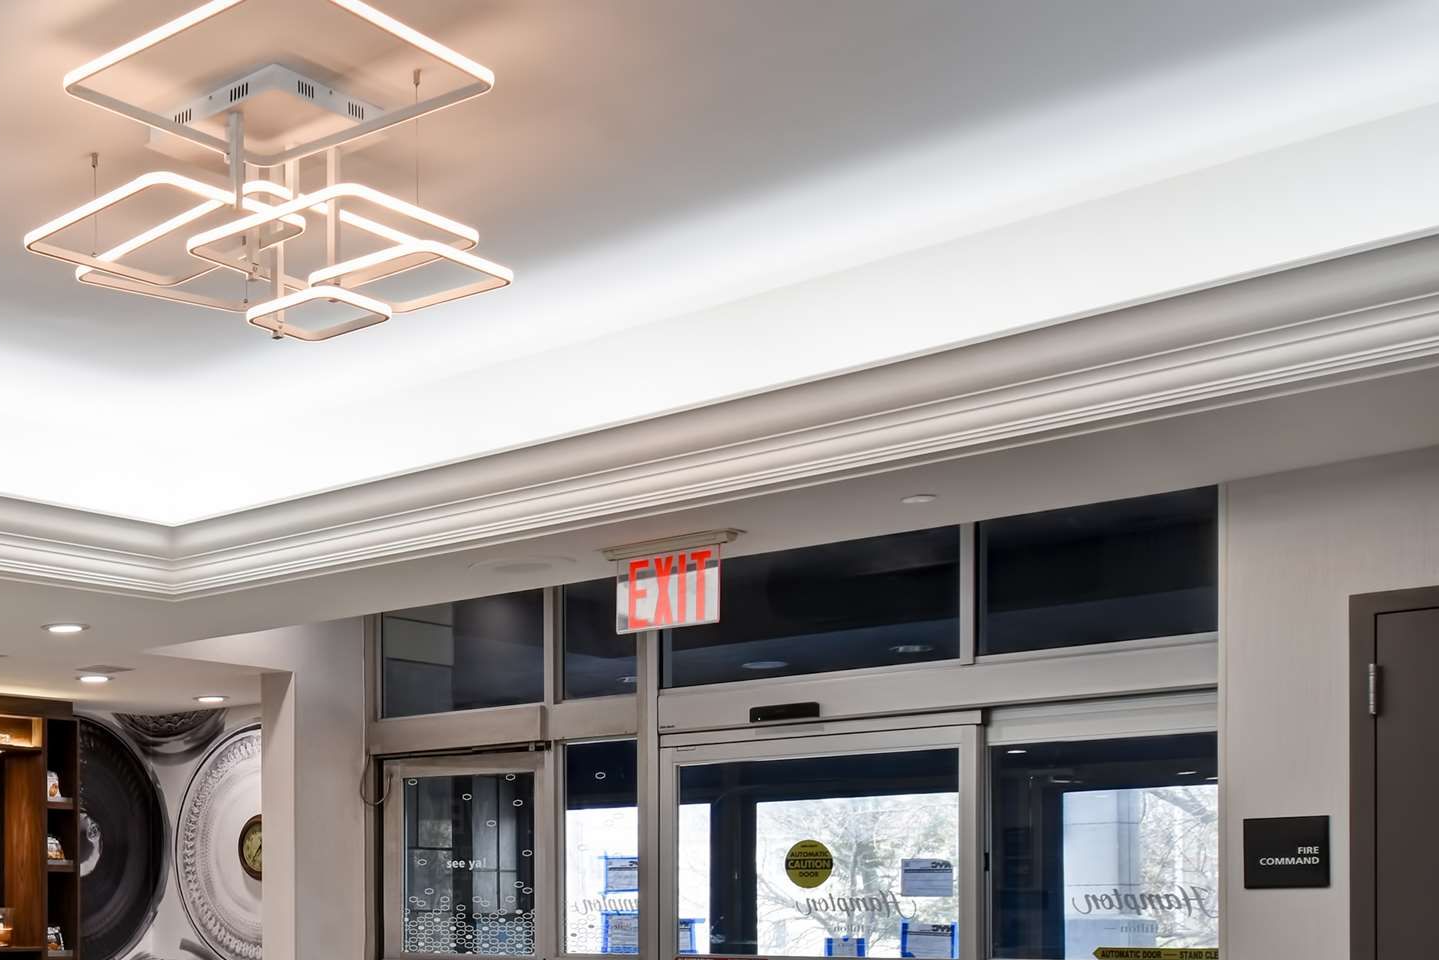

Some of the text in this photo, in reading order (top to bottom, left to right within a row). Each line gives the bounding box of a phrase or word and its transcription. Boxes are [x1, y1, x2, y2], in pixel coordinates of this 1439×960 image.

[628, 550, 712, 629] EXIT
[1297, 846, 1320, 855] FIRE
[446, 857, 486, 871] see ya!
[788, 859, 830, 869] CAUTION
[1259, 856, 1320, 866] COMMAND
[1101, 950, 1141, 959] AUTOMATIC
[1142, 950, 1162, 959] DOOR
[1179, 951, 1202, 960] STAND
